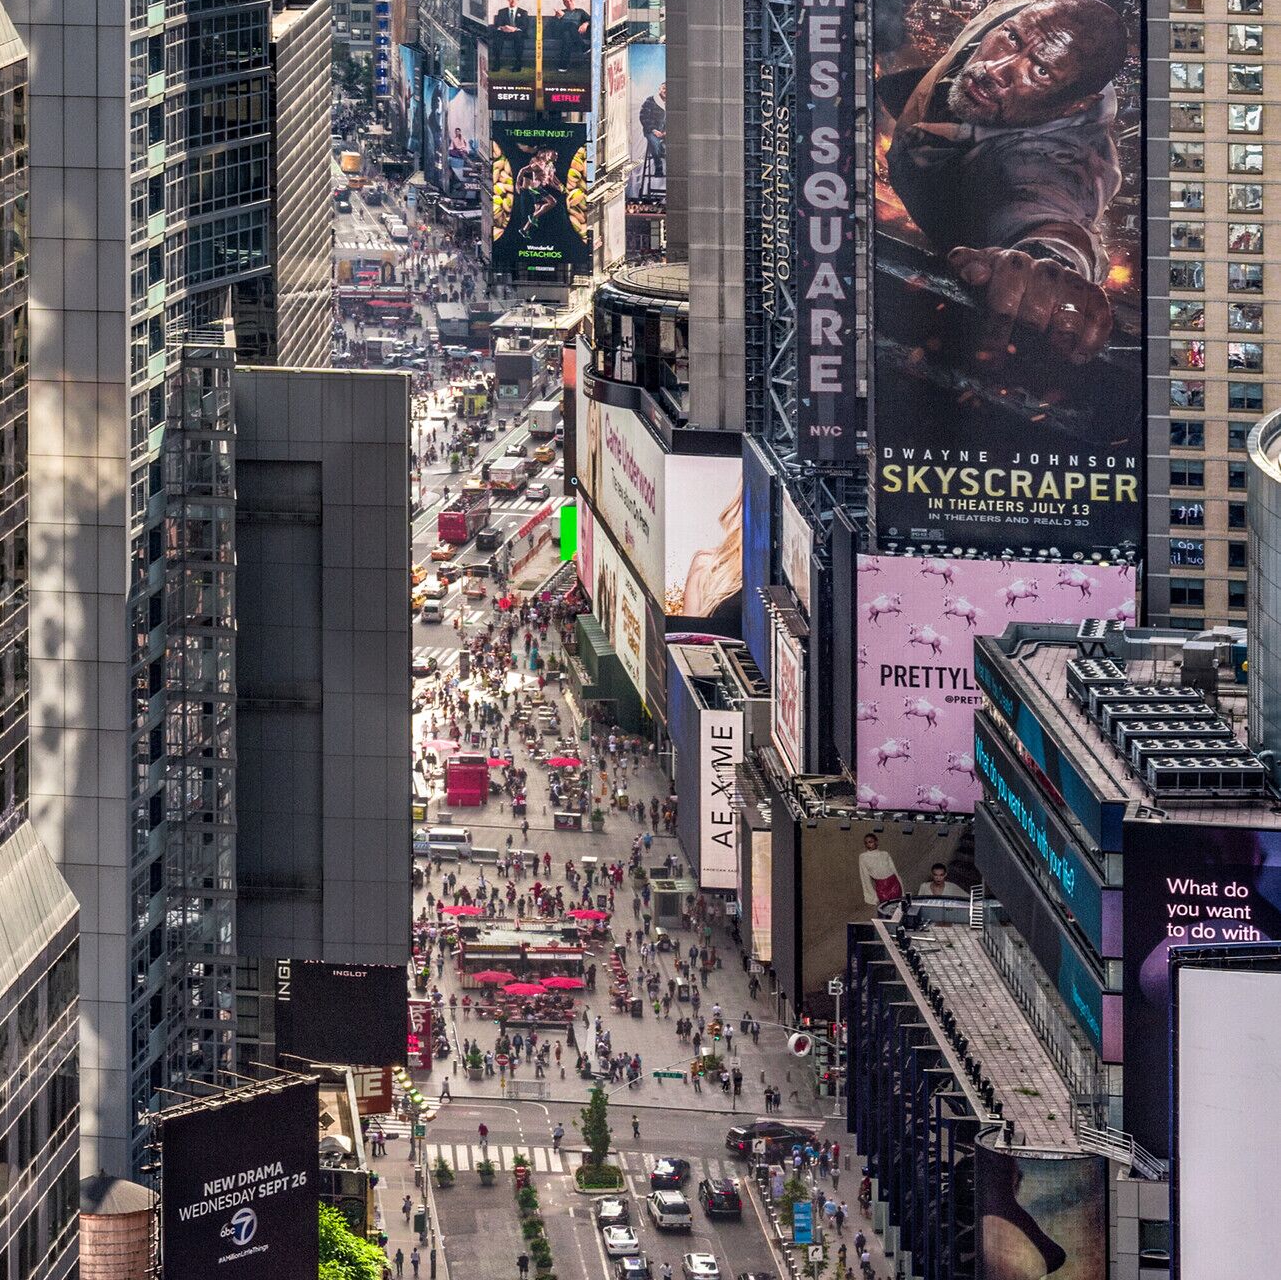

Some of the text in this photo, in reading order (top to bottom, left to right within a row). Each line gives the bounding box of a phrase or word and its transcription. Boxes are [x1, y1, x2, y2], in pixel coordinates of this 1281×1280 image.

[497, 93, 519, 101] SEPT
[551, 94, 581, 103] NETFLIX
[760, 65, 775, 317] AMERICAN EAGLE
[776, 105, 790, 281] OUTFITTERS
[518, 250, 562, 259] PISTACHIOS
[802, 125, 849, 393] SQUARE
[810, 425, 842, 437] NYC
[883, 447, 1136, 469] DWAYNE JOHNSON
[882, 463, 1139, 503] SKYSCRAPER
[928, 498, 1090, 516] IN THEATERS JULY 13
[928, 513, 941, 521] IN
[944, 513, 1002, 523] THEATERS
[1005, 516, 1029, 525] AND
[880, 664, 981, 691] PRETTYL
[1166, 877, 1249, 898] What do
[1166, 903, 1251, 920] you want
[1166, 922, 1261, 942] to do with
[332, 969, 368, 978] INGLOT
[204, 1161, 284, 1197] NEW DRAMA
[178, 1171, 307, 1221] WEDNESDAY SEPT 26
[220, 1225, 236, 1238] abc
